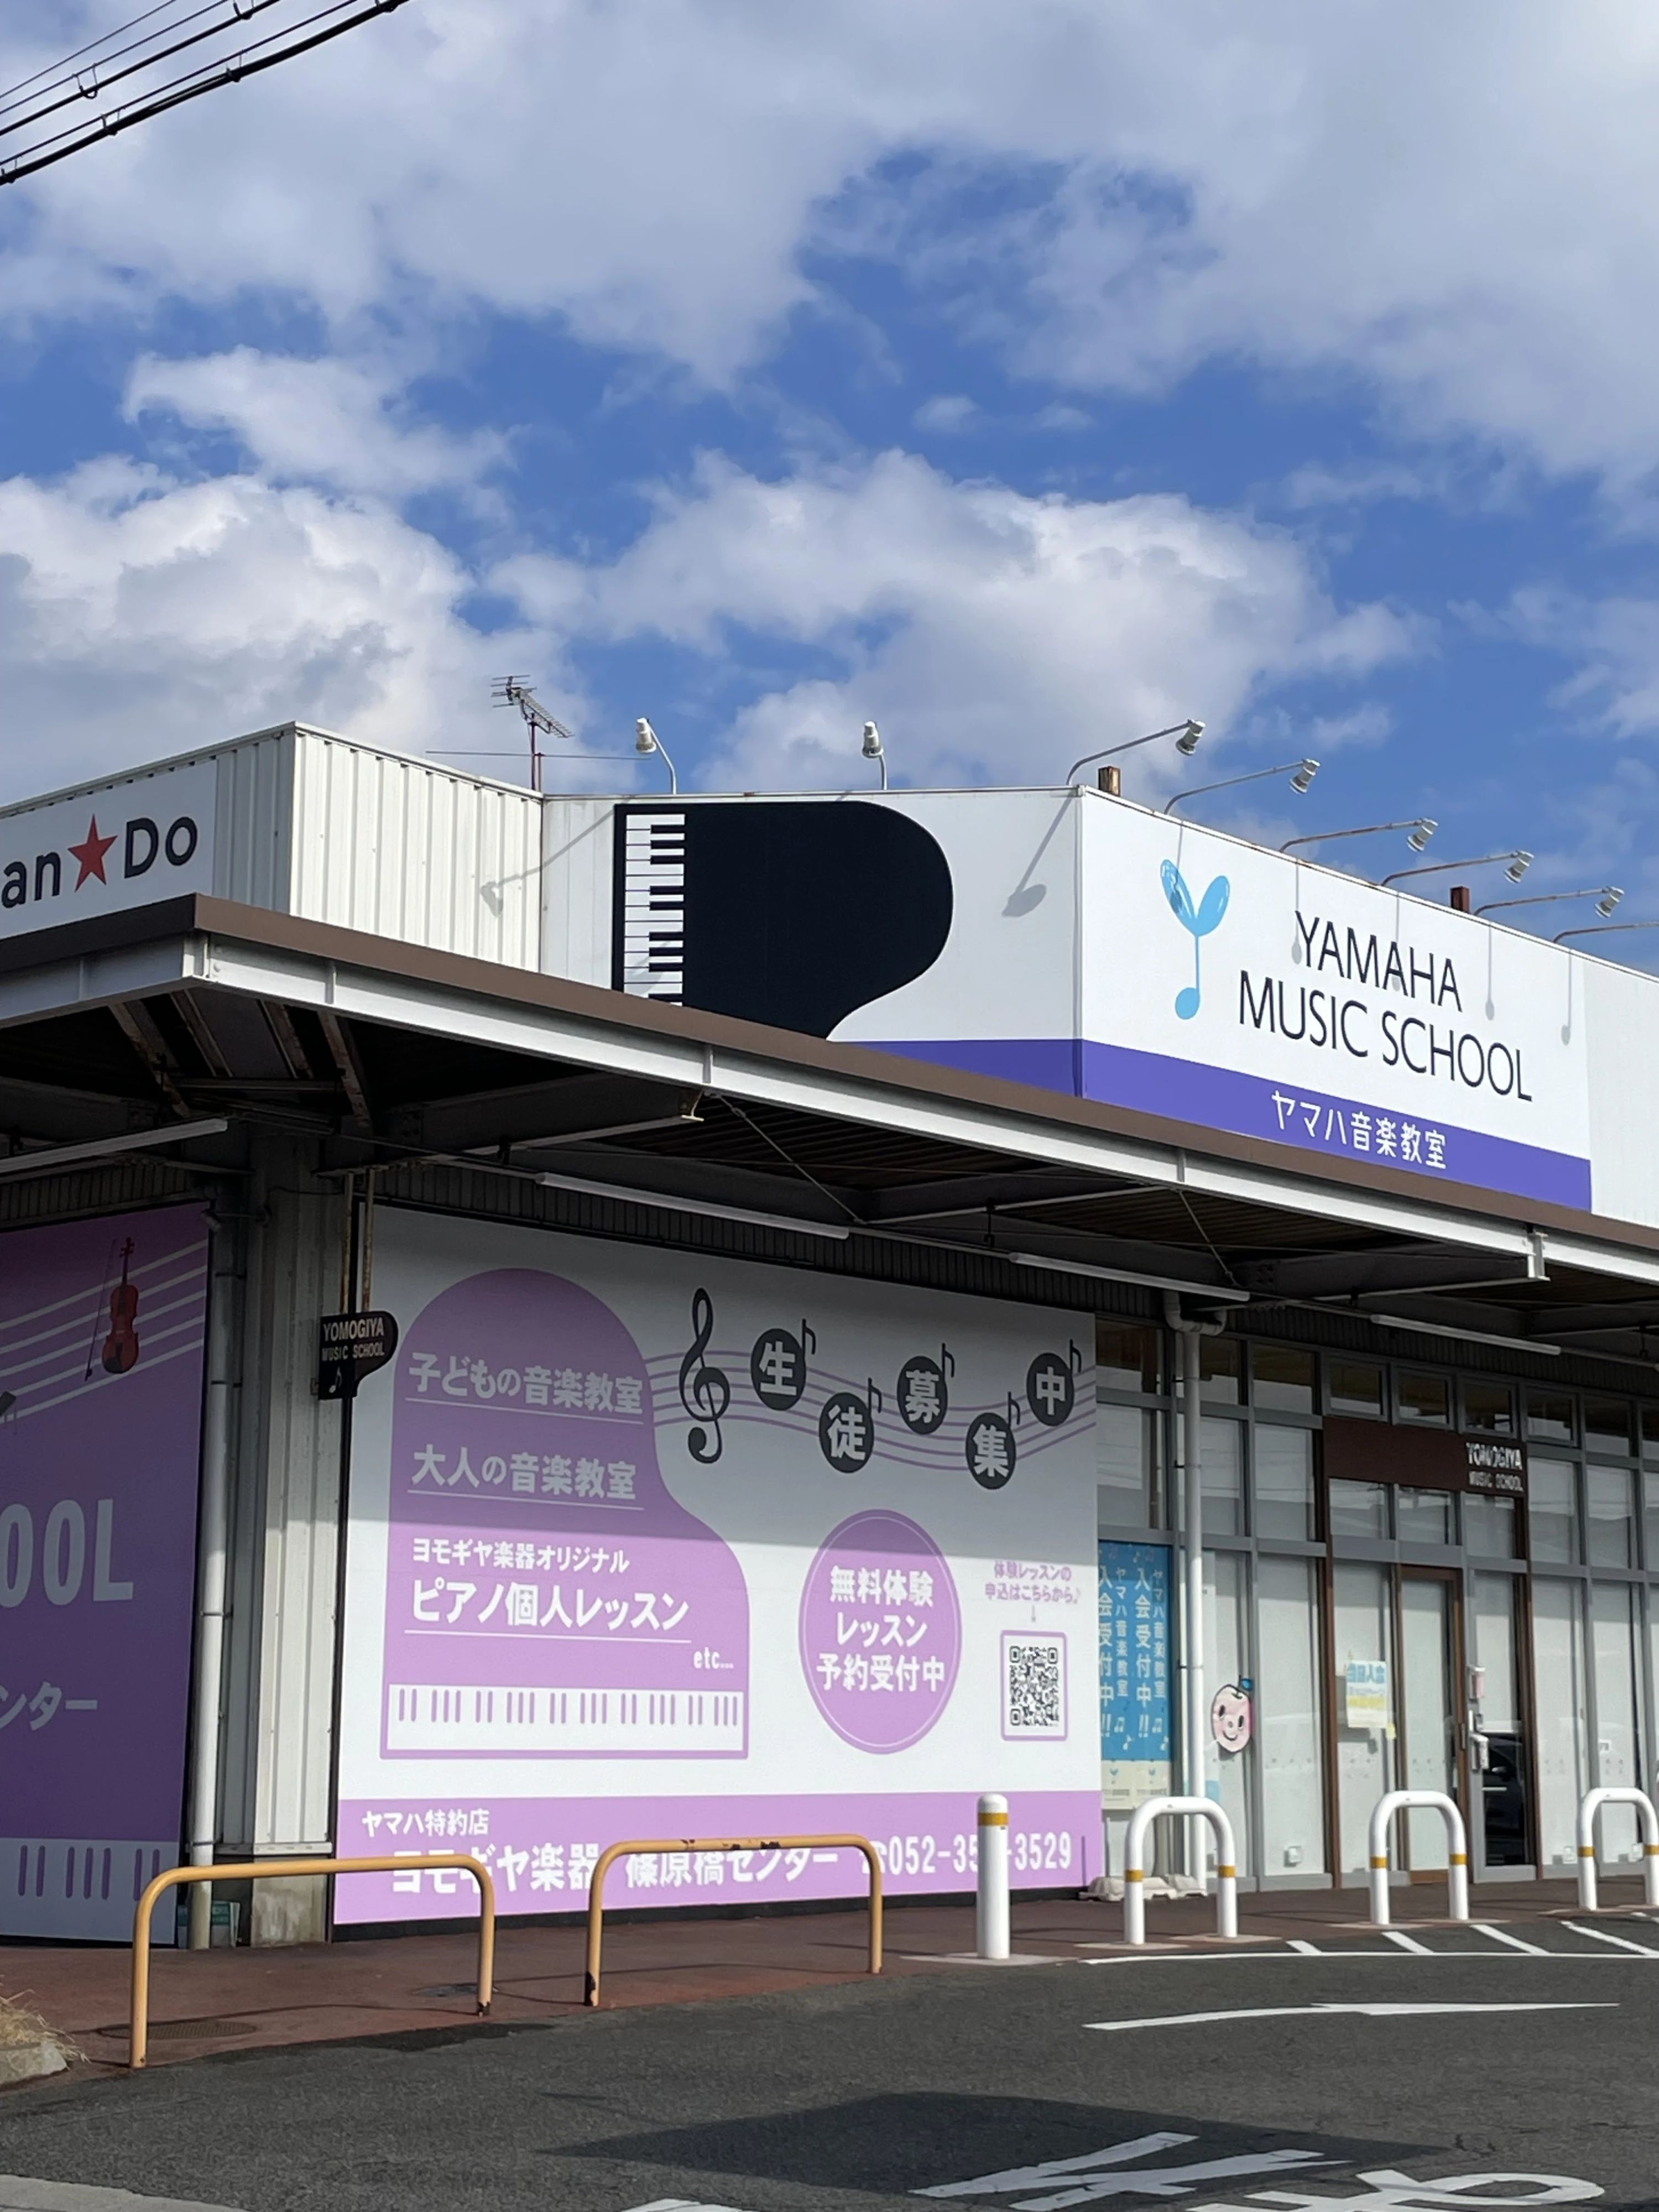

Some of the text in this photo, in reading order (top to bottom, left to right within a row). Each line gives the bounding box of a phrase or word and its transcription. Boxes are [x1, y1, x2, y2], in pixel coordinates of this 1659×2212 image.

[1295, 910, 1463, 1012] YAMAHA
[1240, 969, 1532, 1102] MUSIC SCHOOL
[1271, 1090, 1446, 1169] ヤマハ音楽教室
[322, 1342, 385, 1361] MUSIC SCHOOL
[323, 1317, 384, 1342] YOMOGIYA
[409, 1352, 643, 1414] 子どもの音楽教室
[411, 1443, 636, 1500] 大人の音楽教室
[413, 1537, 630, 1574] ヨモギヤ楽器オリジナル
[994, 1560, 1072, 1582] 体験レッスンの
[413, 1576, 689, 1631] ピアノ個人レッスン
[830, 1564, 934, 1607] 無料体験
[837, 1611, 928, 1648] レッスン
[1115, 1566, 1129, 1697] ヤマハ音楽教室
[1152, 1569, 1166, 1698] ヤマハ音楽教室
[816, 1652, 945, 1692] 予約受付中
[362, 1808, 490, 1838] ヤマハ特約店
[889, 1831, 1072, 1875] 052-35-3529
